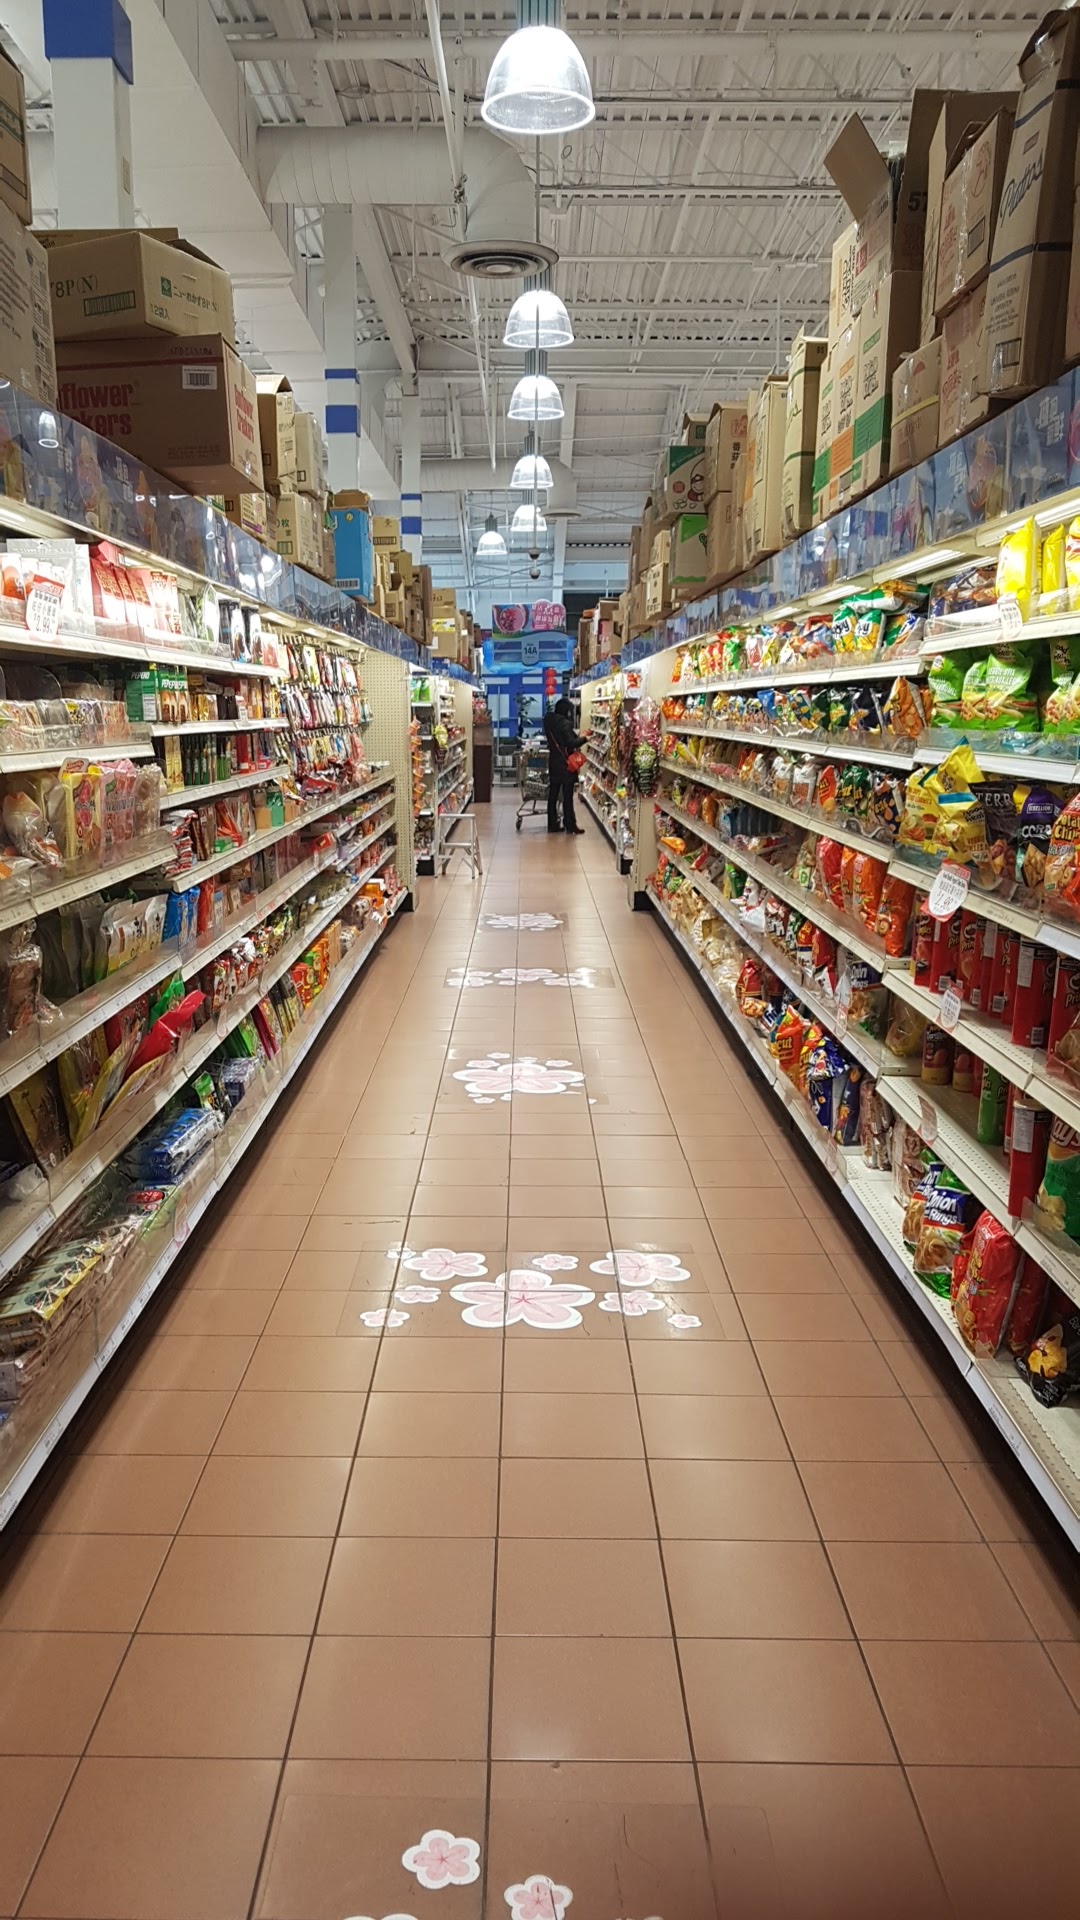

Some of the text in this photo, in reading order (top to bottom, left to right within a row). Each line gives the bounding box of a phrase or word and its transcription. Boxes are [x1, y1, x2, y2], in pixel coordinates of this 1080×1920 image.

[50, 274, 98, 298] 8P(N)
[74, 411, 132, 437] kers
[524, 647, 537, 655] 14A
[131, 671, 150, 680] PEPERO
[927, 1190, 958, 1213] Onion
[928, 1208, 958, 1226] Rings
